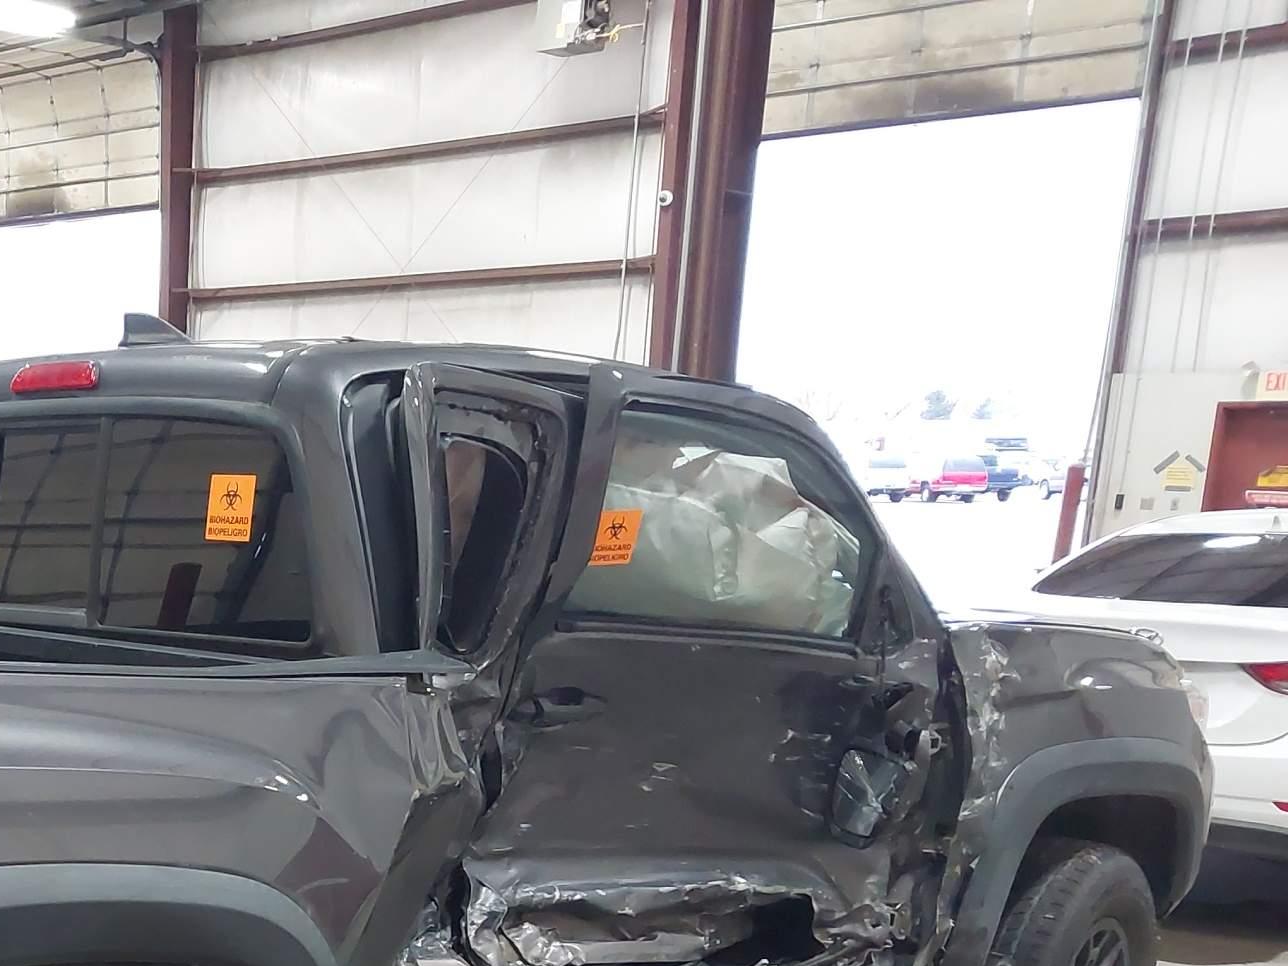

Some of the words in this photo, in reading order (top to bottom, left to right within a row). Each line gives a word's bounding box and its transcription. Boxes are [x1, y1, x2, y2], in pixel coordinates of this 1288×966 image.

[209, 515, 249, 525] BIOHAZARD
[207, 527, 248, 537] BIOPELIGRO
[595, 544, 632, 552] IOHAZARD
